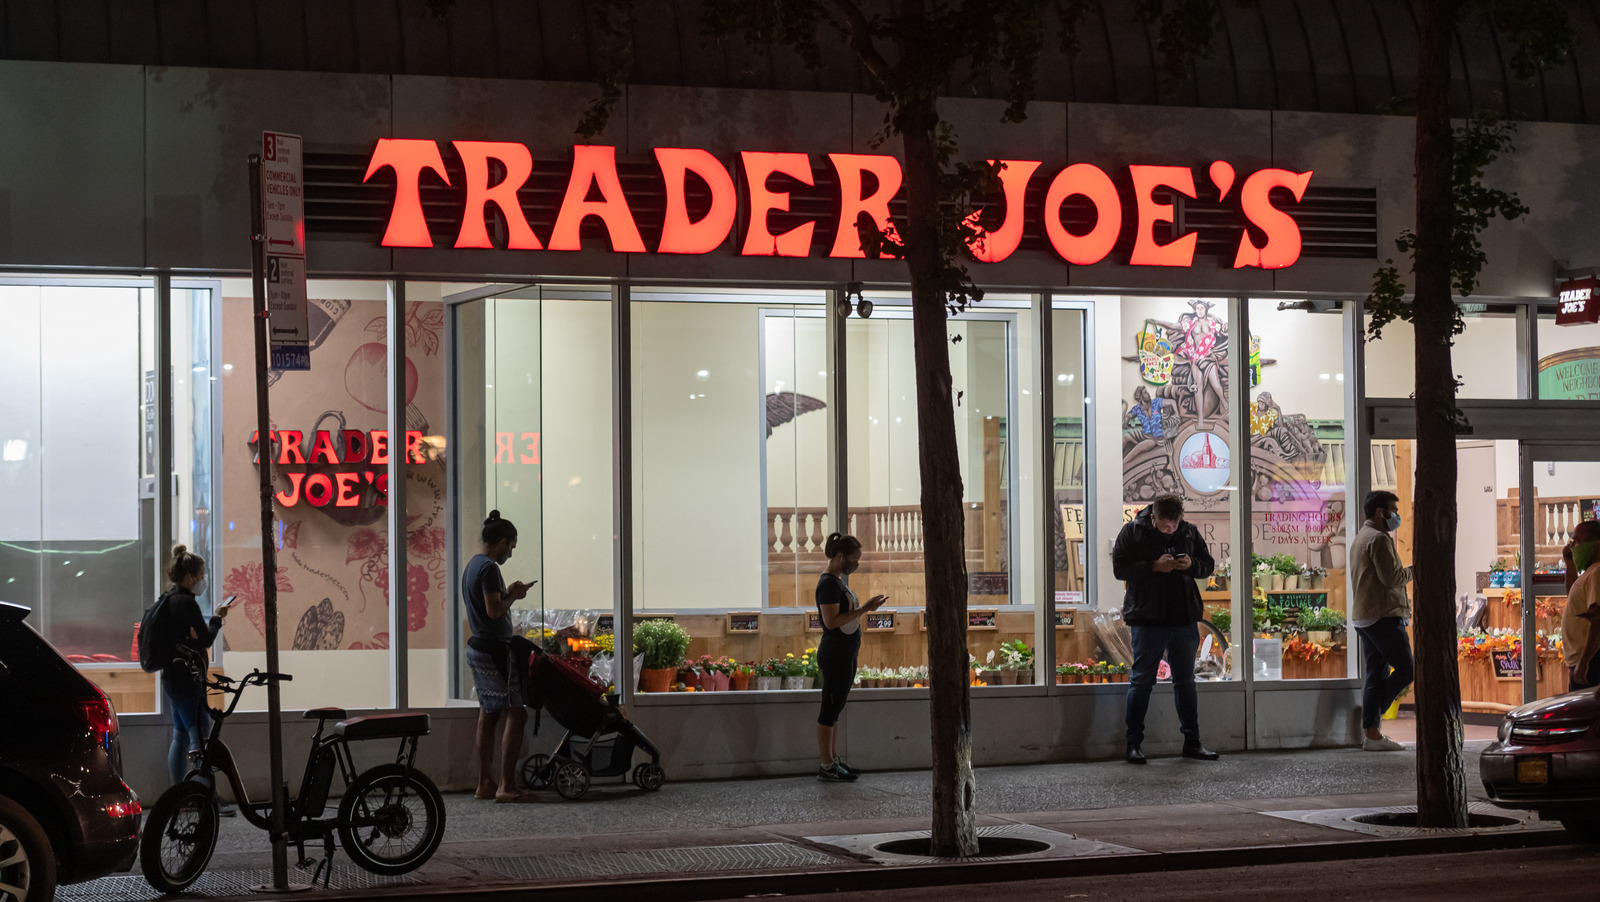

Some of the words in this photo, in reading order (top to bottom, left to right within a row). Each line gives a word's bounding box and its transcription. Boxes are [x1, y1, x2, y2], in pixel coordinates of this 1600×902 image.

[266, 136, 274, 159] 3
[266, 170, 296, 183] COMMERCIAL
[266, 183, 289, 196] VEHICLES
[289, 186, 301, 197] ONLY
[363, 139, 905, 259] TRADER
[958, 160, 1313, 269] JOE'S
[270, 258, 277, 281] 2
[1560, 288, 1592, 303] TRADER
[1561, 301, 1586, 314] JOE'S
[1555, 362, 1598, 381] WELCOME
[1562, 376, 1600, 393] NEIGHBO
[1264, 513, 1305, 522] TRADING
[1307, 512, 1342, 521] HOURS
[1305, 524, 1333, 533] 10:00PM
[1271, 535, 1276, 544] 7
[1277, 535, 1299, 544] DAYS
[1301, 536, 1307, 544] A
[1309, 535, 1333, 544] WEEK
